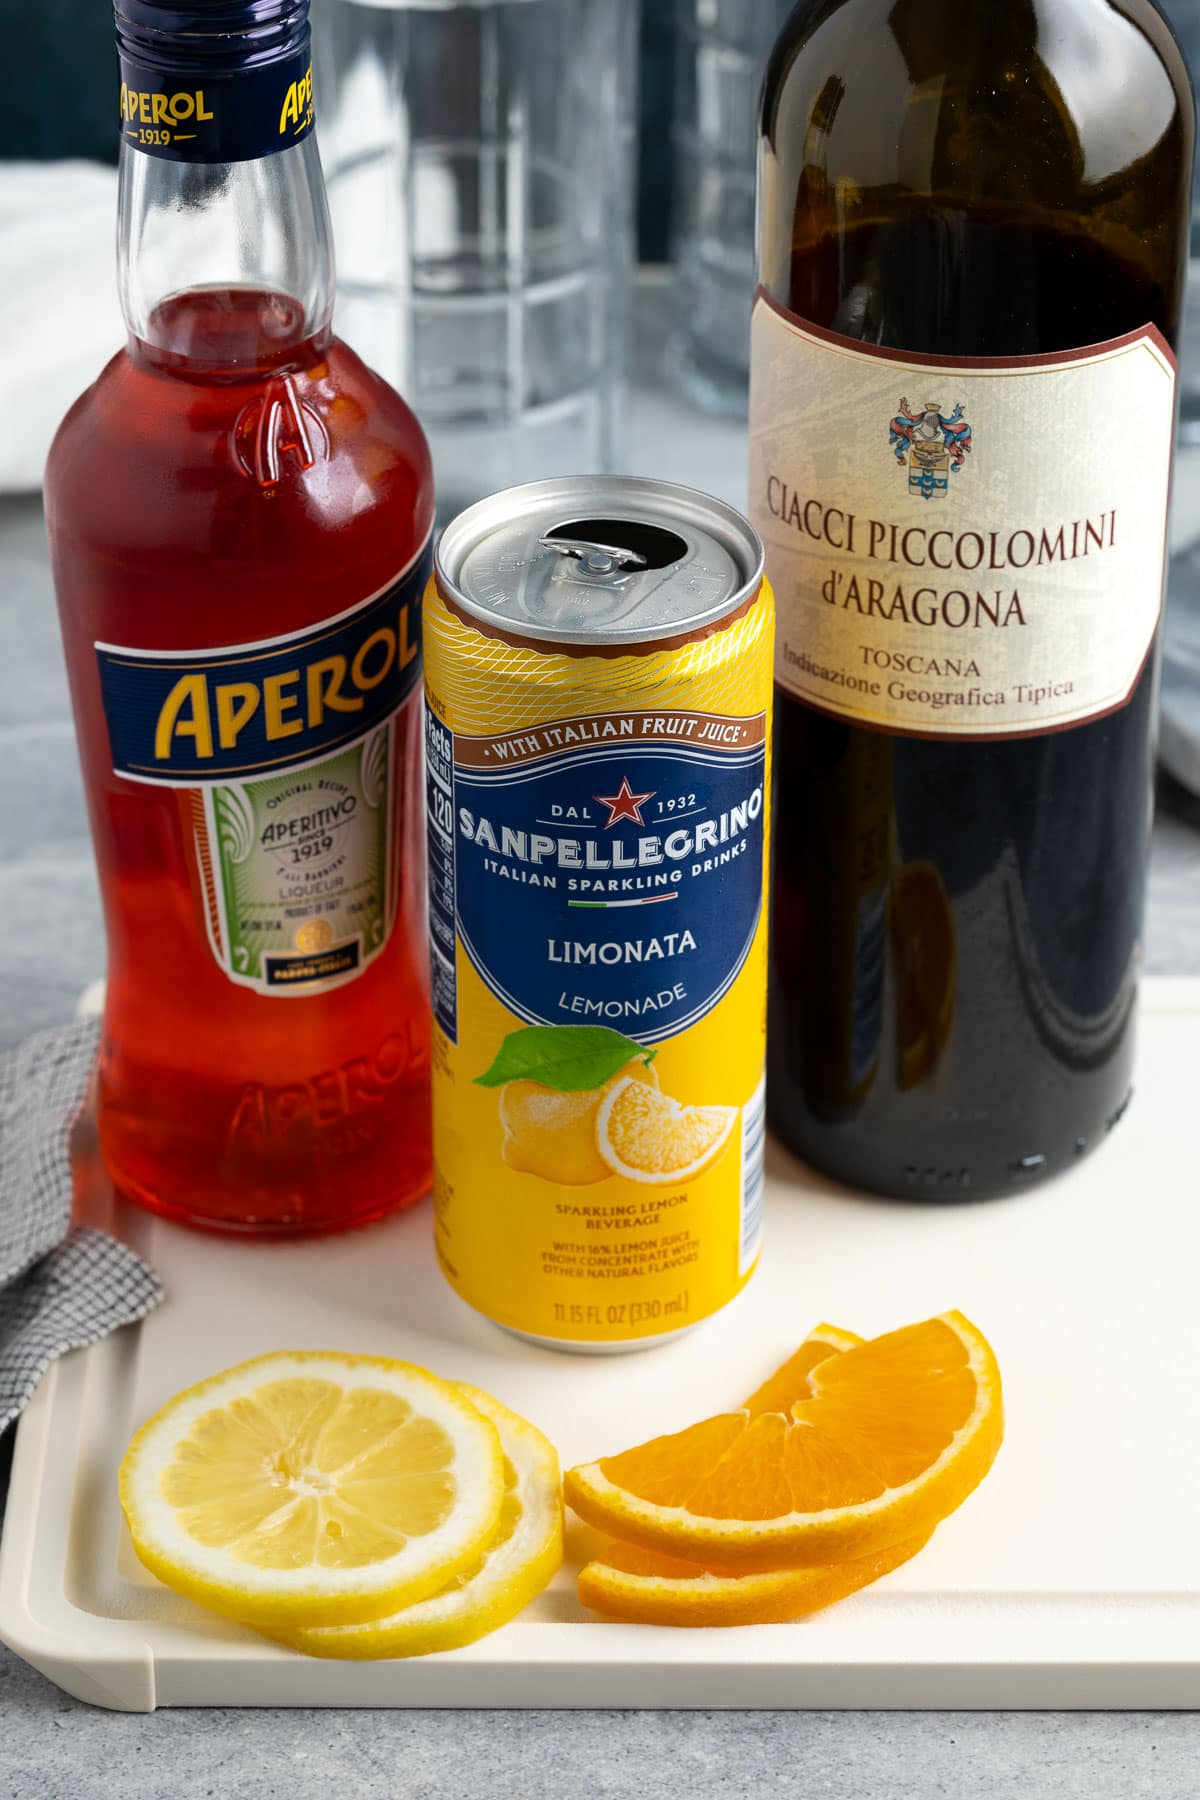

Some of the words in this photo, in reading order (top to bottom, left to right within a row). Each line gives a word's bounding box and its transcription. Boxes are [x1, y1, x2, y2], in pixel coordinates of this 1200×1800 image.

[120, 82, 214, 127] APEROL
[139, 128, 171, 146] 1919
[766, 474, 855, 552] CIACCI
[867, 510, 1118, 569] PICCOLOMINI
[821, 570, 1027, 628] d'ARAGONA
[782, 641, 881, 696] Indicazione
[887, 681, 1005, 709] Geografica
[1012, 679, 1074, 705] Tipica
[858, 646, 981, 678] TOSCANA
[155, 605, 418, 759] APEROL
[491, 737, 540, 760] WITH
[543, 719, 634, 748] ITALIAN
[641, 717, 697, 736] FRUIT
[698, 722, 740, 743] JUICE
[261, 795, 357, 845] APERITIVO
[433, 786, 452, 834] 120
[551, 804, 592, 820] DAL
[656, 794, 697, 814] 1932
[458, 788, 762, 870] SANPELLEGRINO
[291, 836, 333, 864] 1919
[484, 858, 557, 888] ITALIAN
[568, 870, 682, 891] SPARKLING
[692, 839, 747, 877] DRINKS
[279, 876, 344, 900] LIQUEUR
[548, 930, 697, 965] LIMONATA
[558, 982, 687, 1017] LEMONADE
[555, 1203, 636, 1217] SPARKLING
[640, 1193, 688, 1213] LEMON
[586, 1214, 660, 1230] BEVERAGE
[542, 1252, 576, 1264] FROM
[579, 1248, 668, 1266] CONCENTRATE
[672, 1240, 699, 1256] WITH
[552, 1241, 585, 1253] WITH
[614, 1240, 657, 1254] LEMON
[543, 1264, 583, 1277] OTHER
[587, 1265, 645, 1279] NATURAL
[648, 1252, 698, 1273] FLAVORS
[587, 1305, 602, 1324] FL
[606, 1304, 626, 1324] OZ
[629, 1299, 661, 1327] (330
